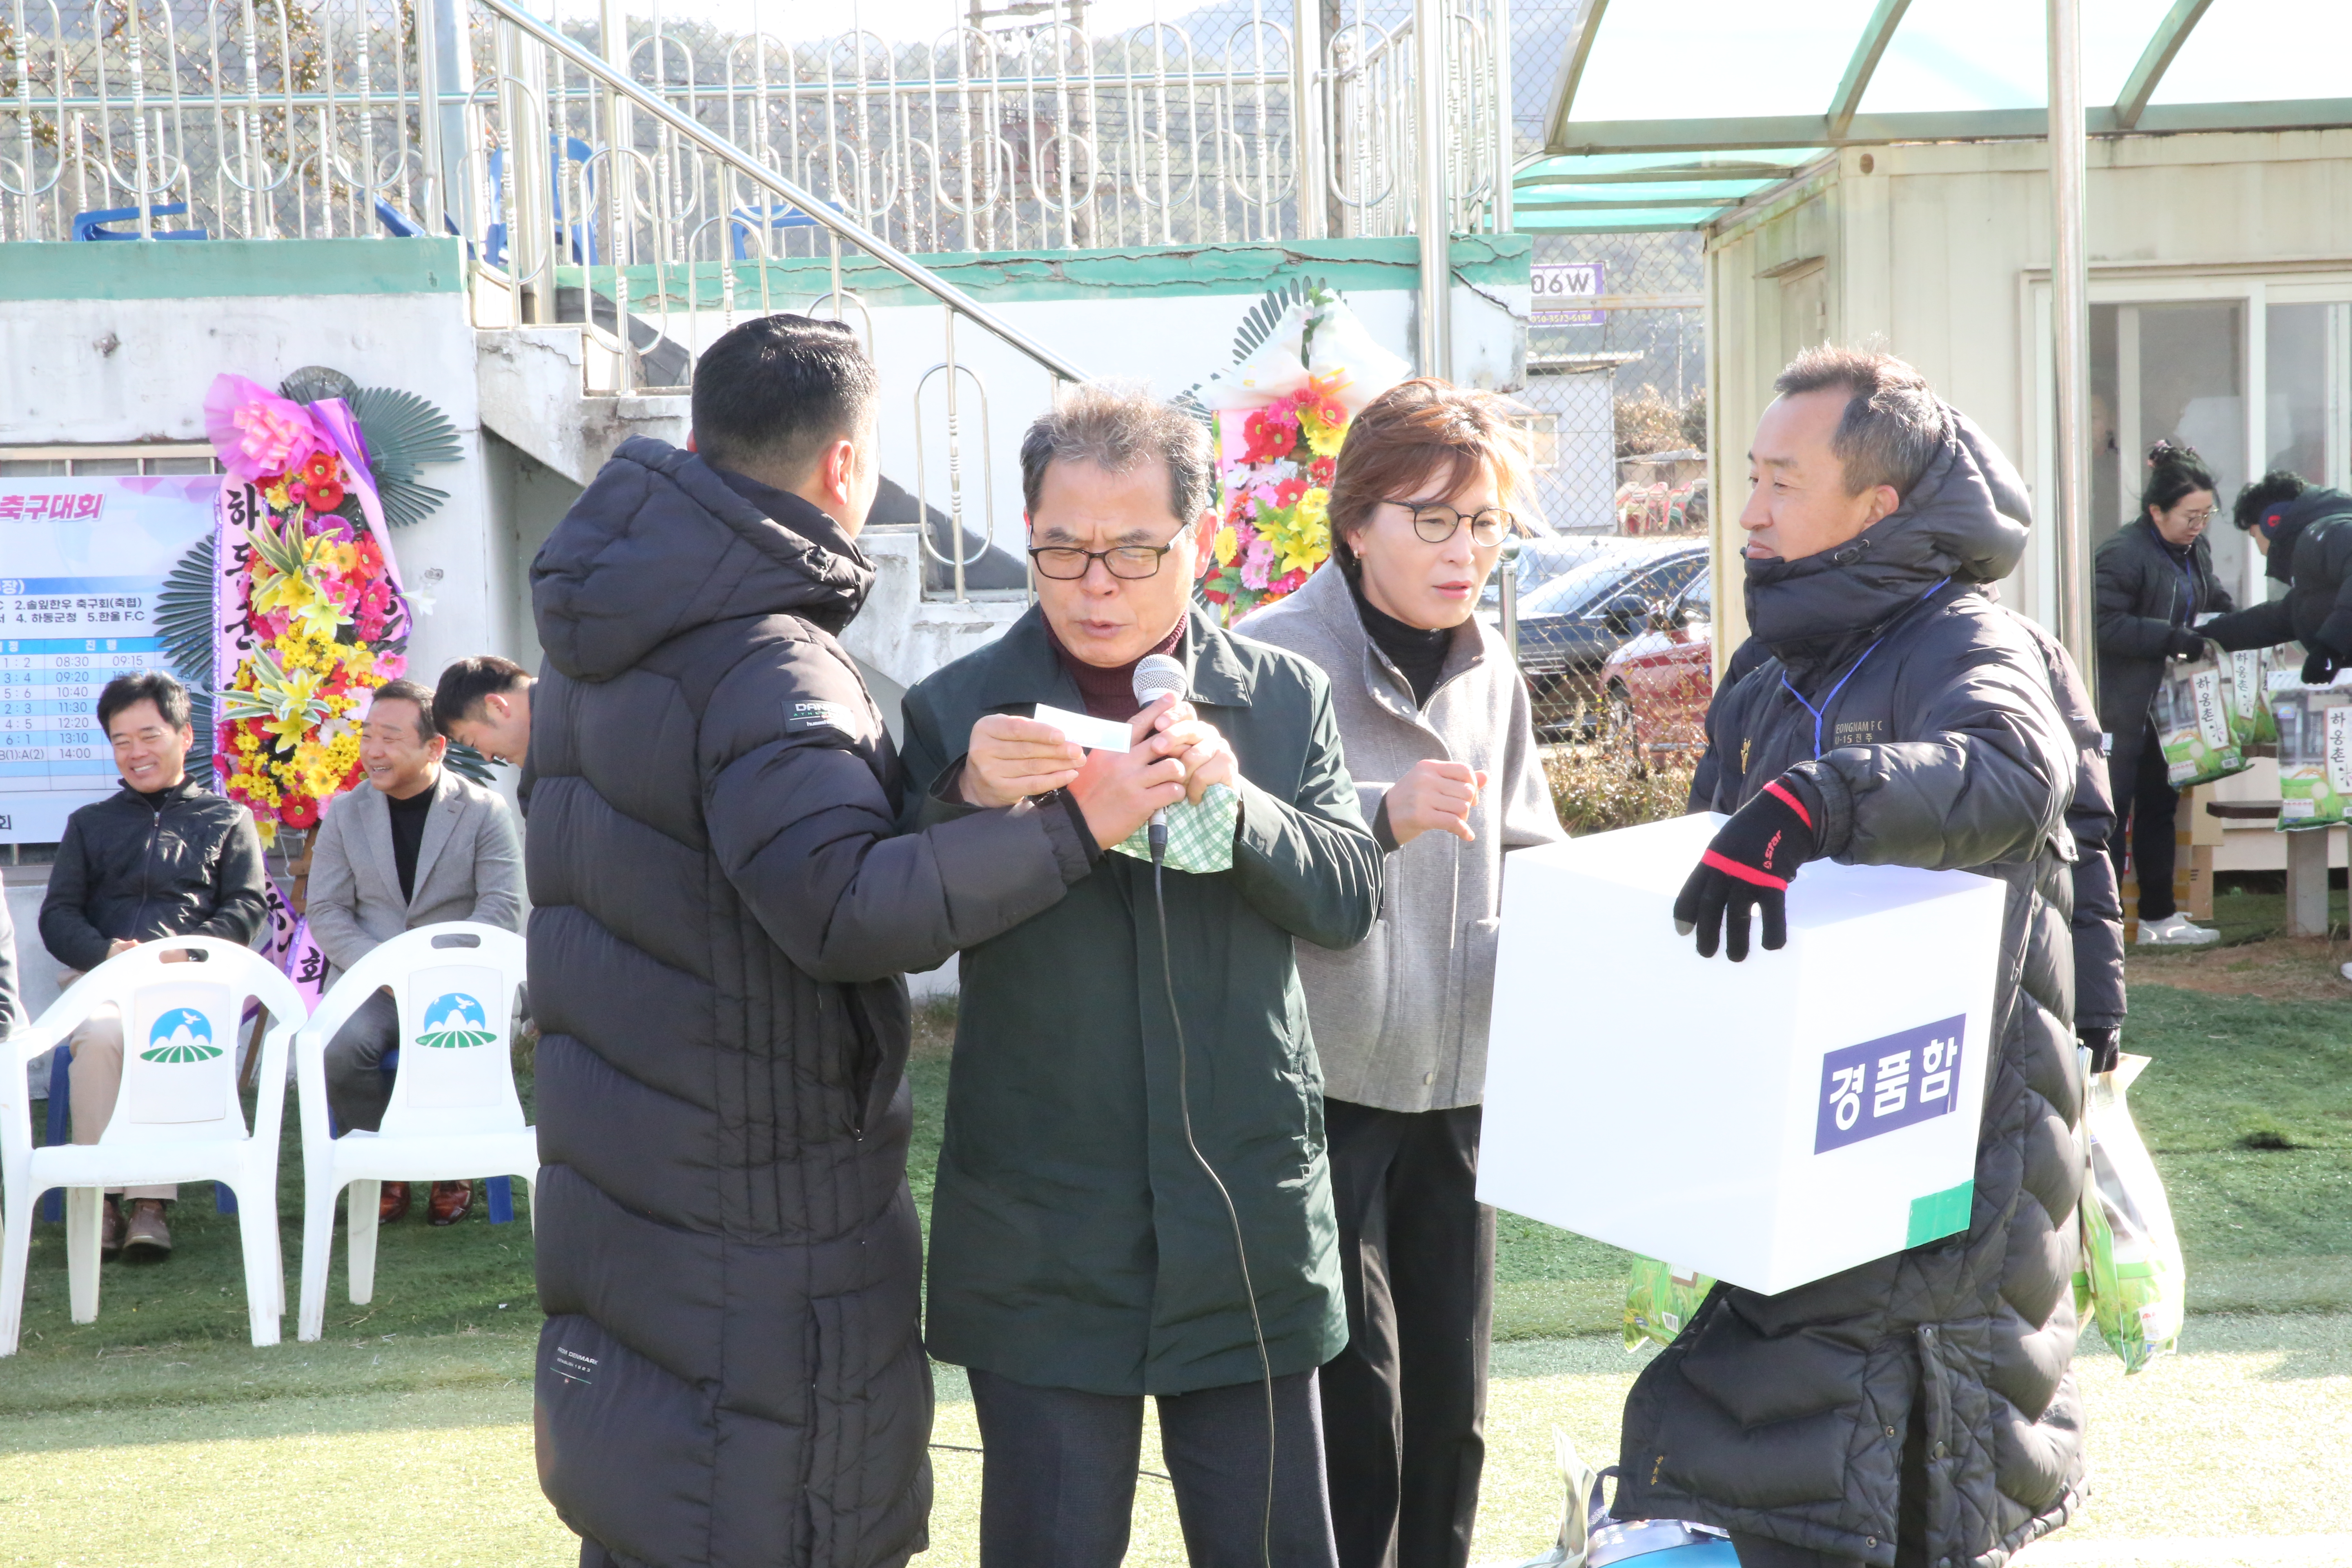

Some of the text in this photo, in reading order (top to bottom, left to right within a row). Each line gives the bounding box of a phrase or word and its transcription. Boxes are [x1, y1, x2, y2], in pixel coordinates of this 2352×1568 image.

[0, 493, 104, 520] 축구대회
[76, 597, 142, 609] 축구회(축협)
[16, 613, 27, 623] 4.
[31, 612, 77, 623] 하동군청
[125, 611, 145, 621] F.C
[56, 656, 89, 667] 08:30
[113, 655, 143, 666] 09:15
[56, 671, 89, 682] 09:20
[57, 686, 88, 697] 10:40
[59, 702, 87, 713] 11:30
[58, 717, 89, 728] 12:20
[60, 732, 89, 744] 13:10
[1835, 735, 1853, 745] U-15
[60, 748, 91, 759] 14:00
[1829, 1036, 1958, 1131] 경품함
[568, 1351, 599, 1365] DENMARK
